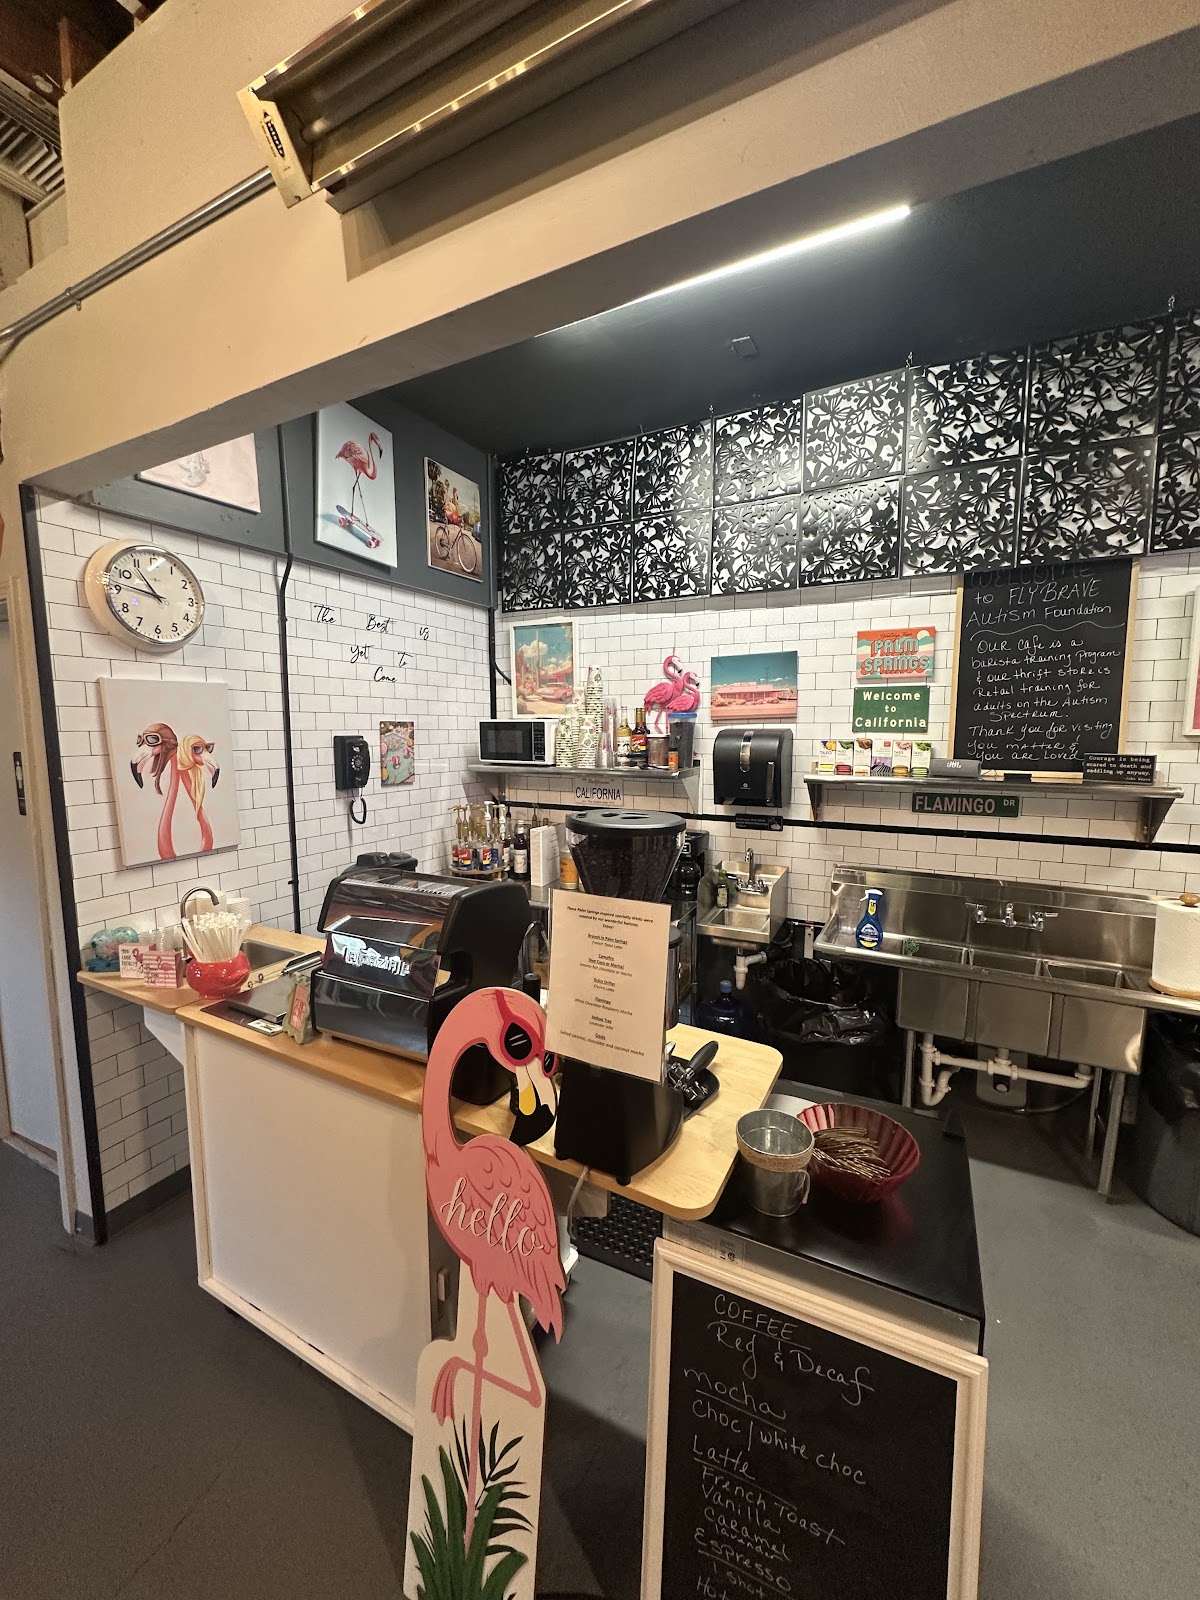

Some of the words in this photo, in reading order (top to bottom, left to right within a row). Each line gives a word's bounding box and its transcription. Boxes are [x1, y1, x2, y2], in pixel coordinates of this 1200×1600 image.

[133, 558, 140, 568] 11
[119, 569, 132, 579] 10
[170, 566, 174, 575] 1
[114, 584, 122, 594] 9
[182, 580, 188, 590] 2
[188, 598, 194, 607] 3
[975, 593, 994, 604] to
[122, 603, 129, 613] 8
[1044, 604, 1112, 619] Foundation
[136, 616, 144, 626] 7
[183, 614, 190, 622] 4
[313, 604, 336, 623] The
[366, 614, 396, 634] Best
[154, 625, 162, 634] 6
[172, 623, 178, 632] 5
[872, 637, 919, 656] PALM
[1049, 641, 1062, 651] is
[1070, 639, 1084, 647] a
[862, 655, 930, 674] SPRINGS
[373, 666, 397, 683] Come
[976, 671, 981, 685] &
[1013, 668, 1052, 681] thrift
[1097, 667, 1111, 675] is
[1020, 682, 1072, 695] training
[863, 691, 921, 701] Welcome
[885, 704, 896, 712] to
[974, 701, 1012, 712] adults
[1033, 697, 1058, 707] the
[855, 716, 926, 728] California
[1015, 724, 1044, 741] you
[1072, 721, 1114, 740] visiting
[1069, 735, 1080, 752] &
[976, 751, 1004, 765] you
[576, 786, 622, 800] CALIFORNIA
[914, 796, 996, 814] FLAMINGO
[440, 1177, 545, 1257] hello
[714, 1294, 798, 1340] COFFEE
[708, 1321, 756, 1380] Reg
[774, 1341, 784, 1371] &
[790, 1350, 875, 1406] Decaf
[693, 1434, 756, 1480] Latte
[702, 1465, 766, 1510] French
[774, 1502, 845, 1545] Toast
[702, 1484, 780, 1534] Vanilla
[694, 1528, 791, 1592] Espresso
[697, 1576, 728, 1600] Hot
